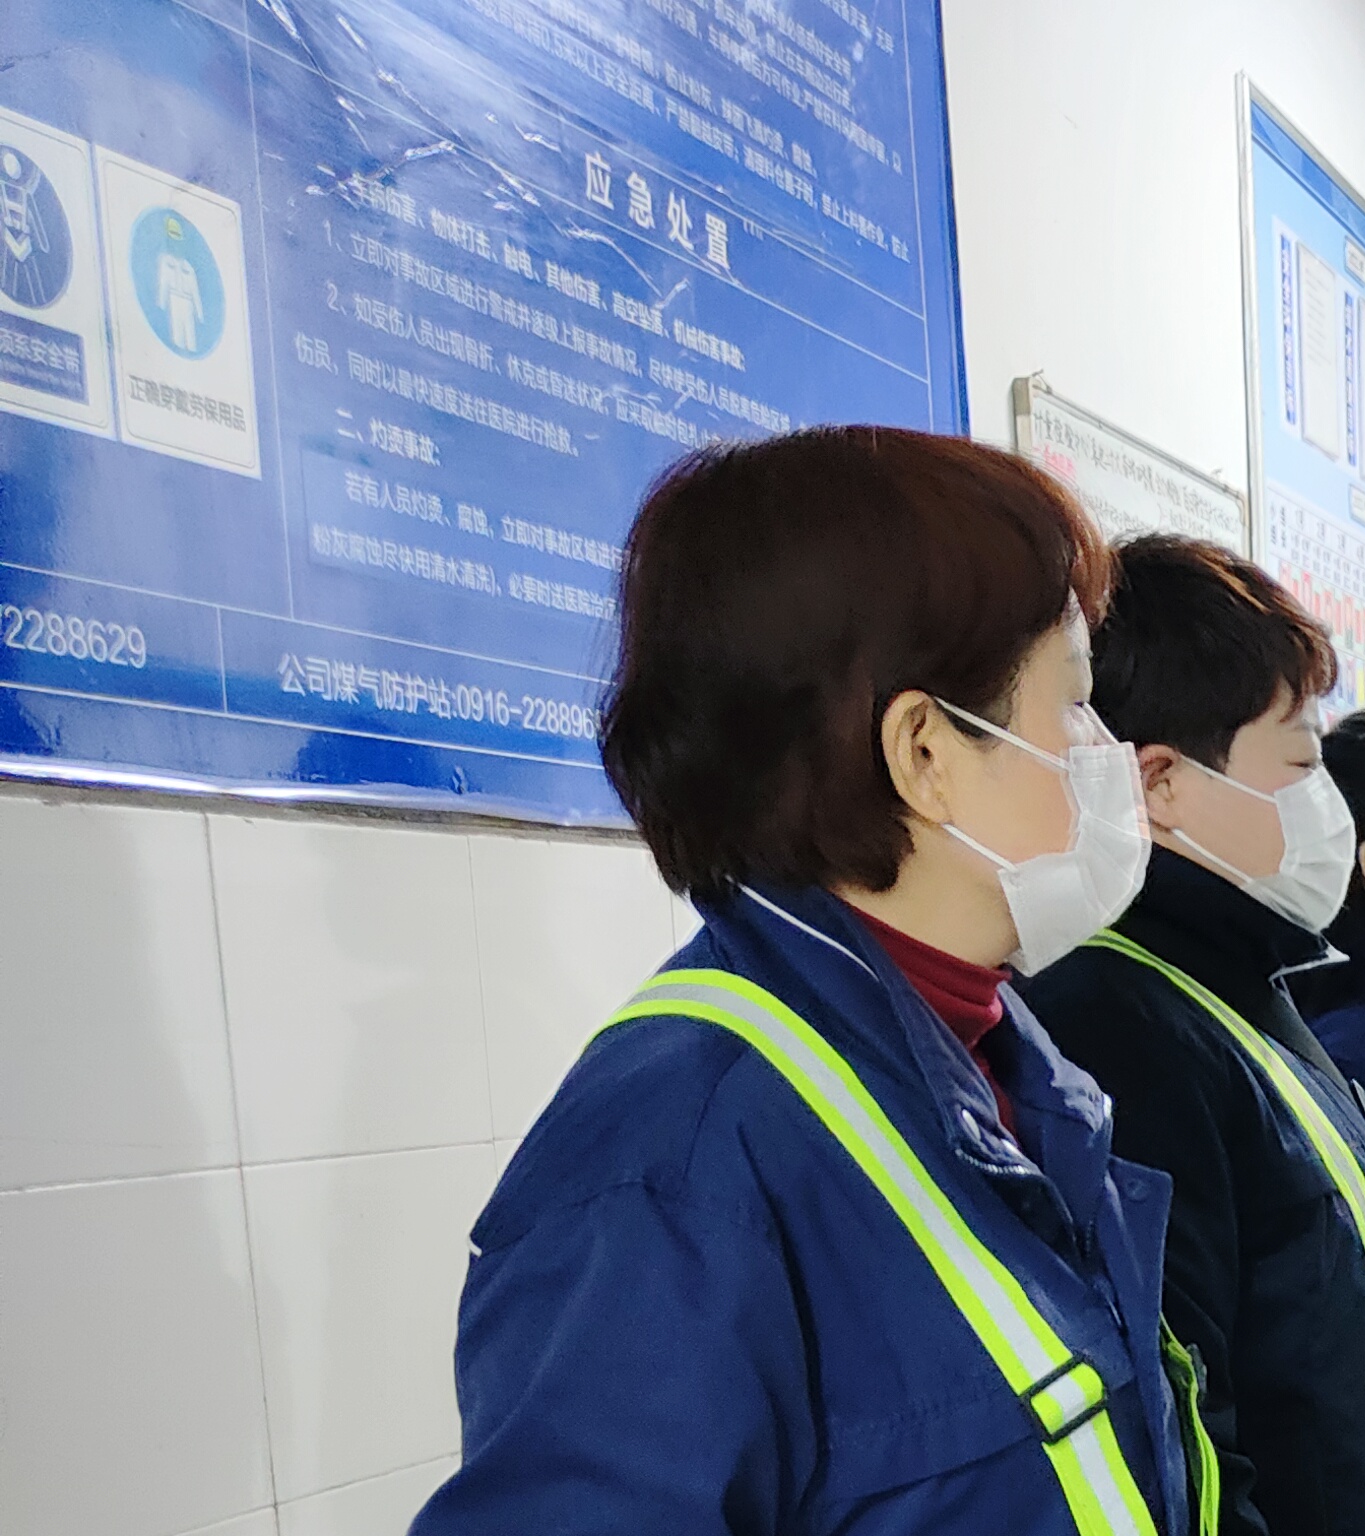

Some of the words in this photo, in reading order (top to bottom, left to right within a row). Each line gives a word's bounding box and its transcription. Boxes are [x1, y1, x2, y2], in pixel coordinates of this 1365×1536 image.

[585, 151, 732, 272] 应急处置
[3, 604, 147, 669] 2288629
